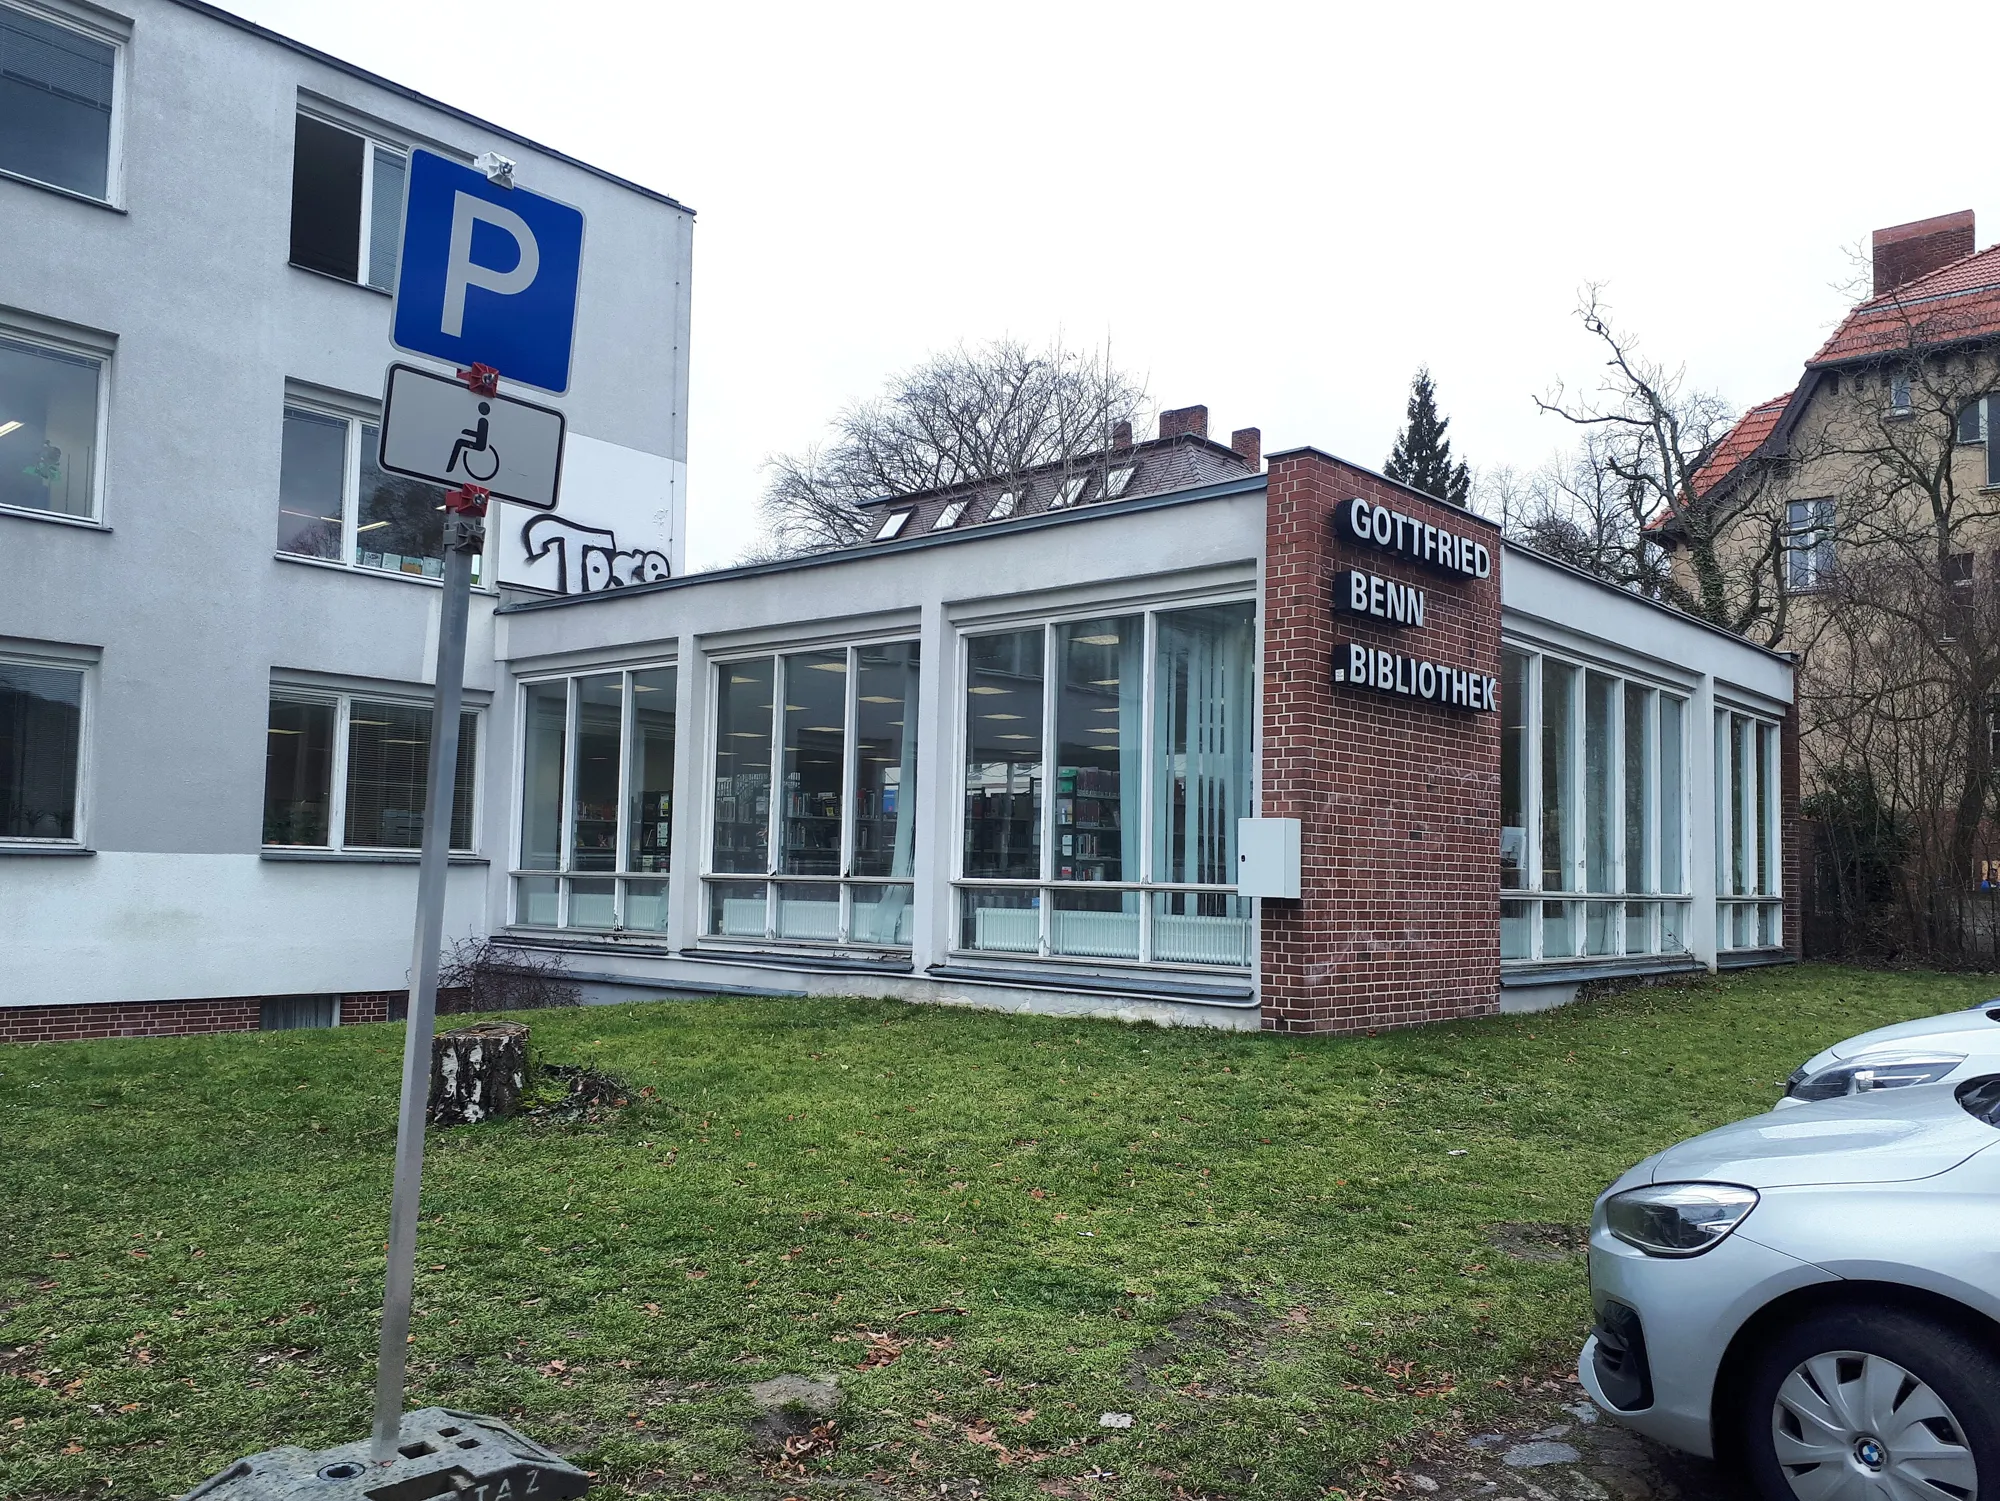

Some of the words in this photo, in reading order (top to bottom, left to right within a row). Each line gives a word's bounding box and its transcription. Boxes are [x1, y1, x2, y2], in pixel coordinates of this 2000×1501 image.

[441, 190, 540, 337] P
[1351, 498, 1491, 579] GOTTFRIED
[1351, 570, 1424, 626] BENN
[1350, 643, 1497, 711] BIBLIOTHEK
